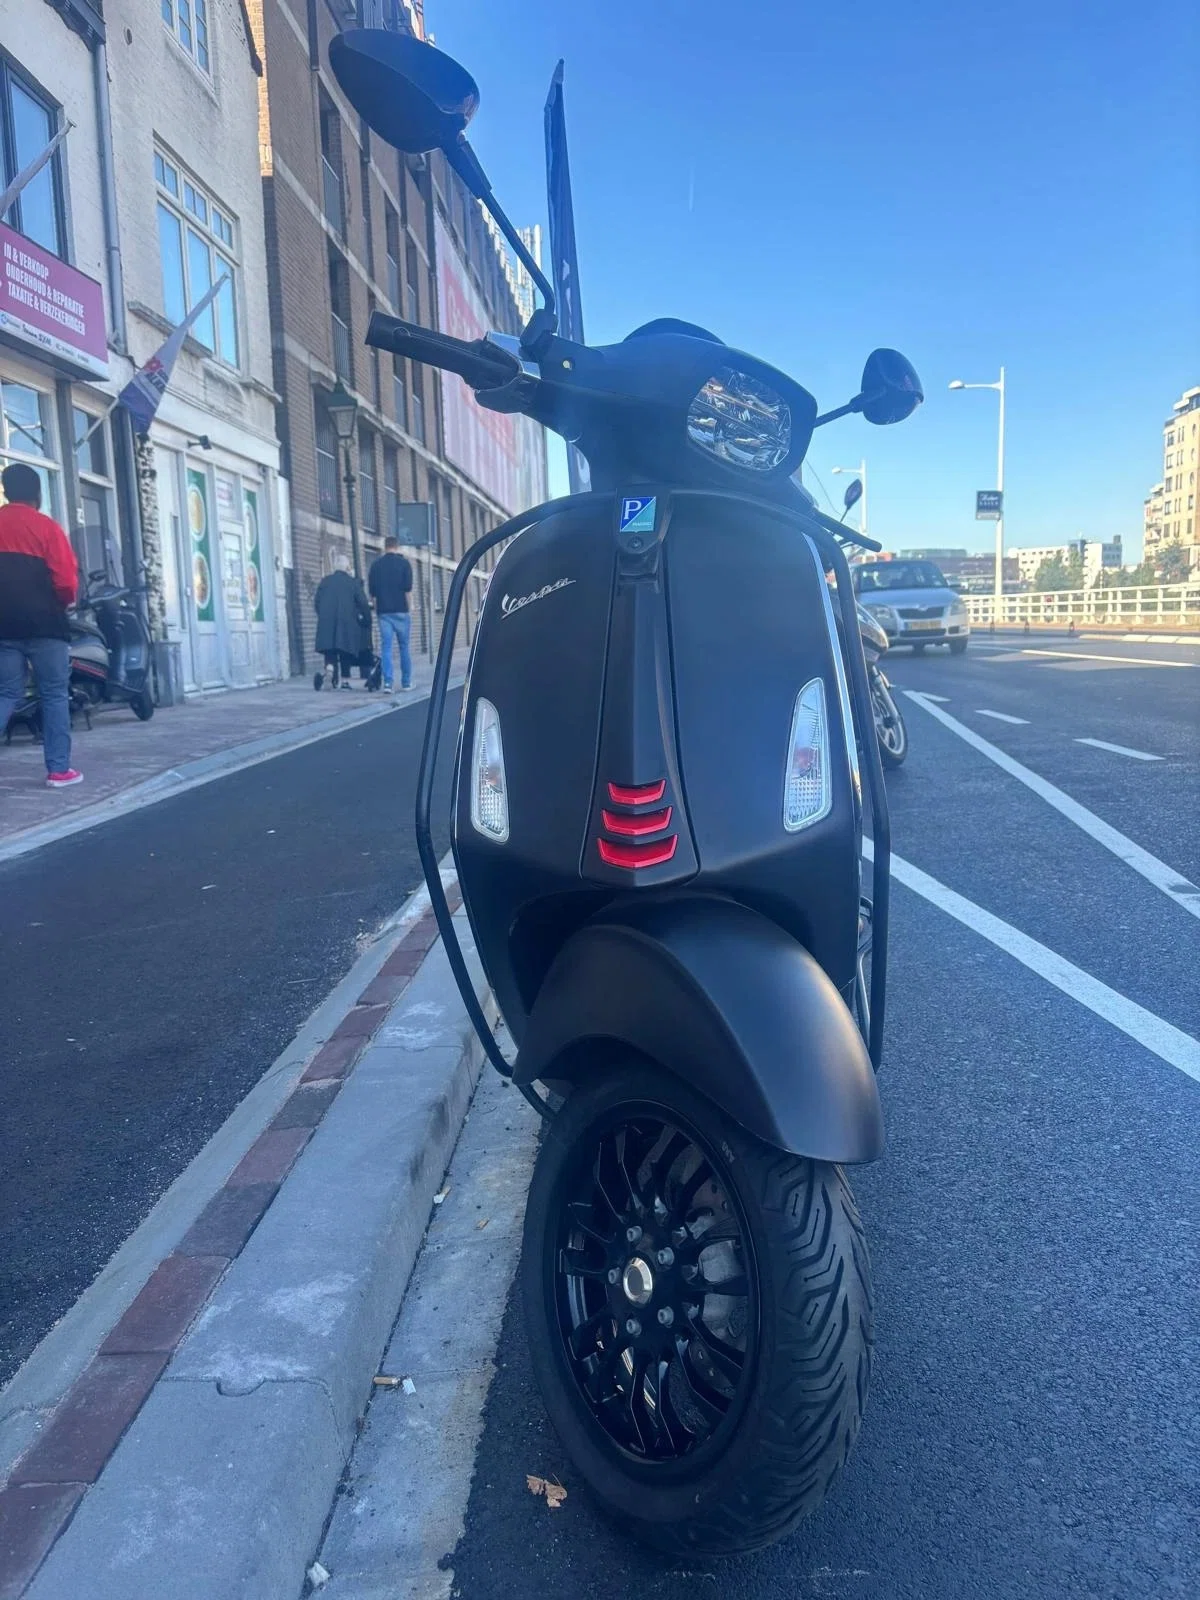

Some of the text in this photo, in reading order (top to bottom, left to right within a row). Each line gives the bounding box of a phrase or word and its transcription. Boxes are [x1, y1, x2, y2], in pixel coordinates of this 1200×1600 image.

[4, 242, 49, 280] IN & VERKOOP
[6, 262, 84, 319] ONDERHOUD & REPARATIE
[8, 281, 34, 308] TAXATIE
[33, 295, 39, 312] &
[623, 500, 642, 520] P
[501, 577, 576, 619] Vespa
